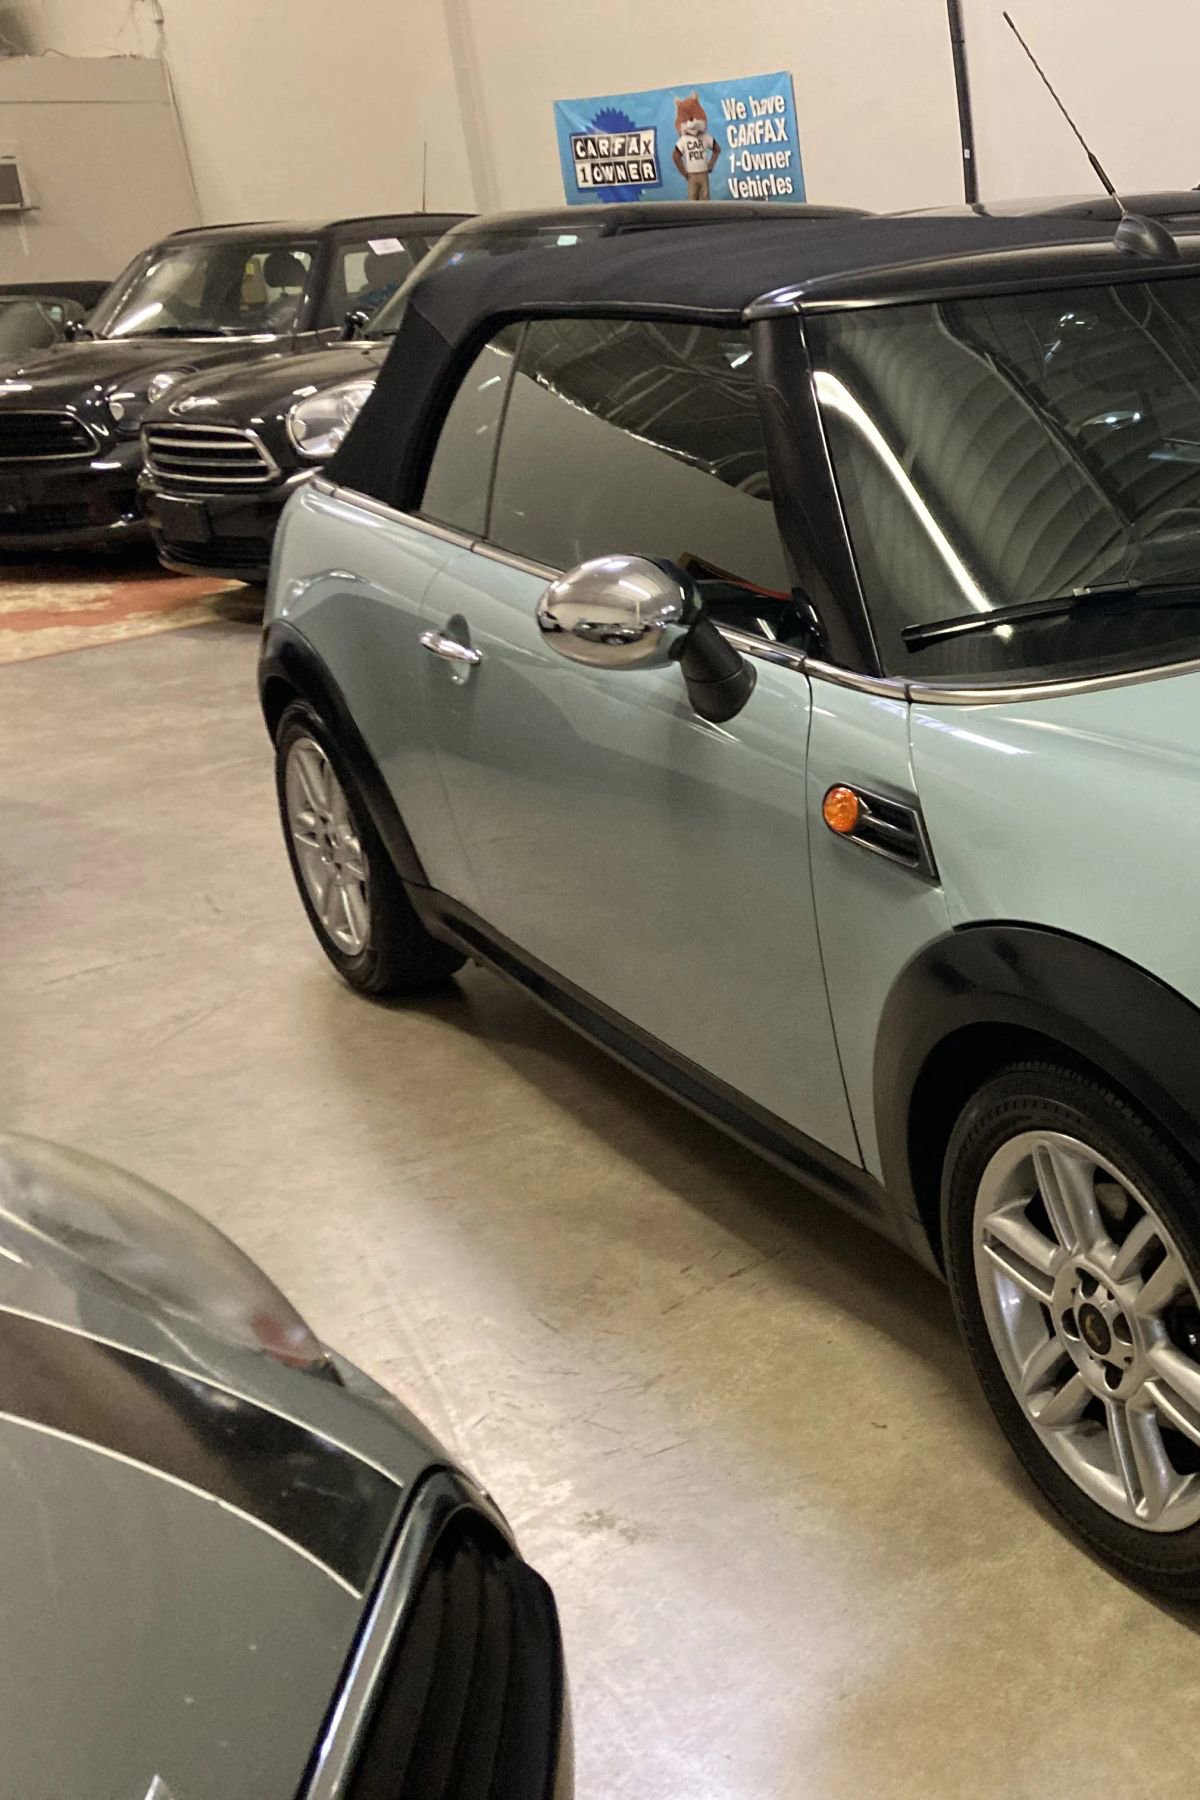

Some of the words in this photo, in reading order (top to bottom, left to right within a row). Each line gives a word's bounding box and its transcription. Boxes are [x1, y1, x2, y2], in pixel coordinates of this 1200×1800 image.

[721, 97, 747, 121] We
[748, 95, 785, 117] have
[726, 117, 789, 148] CARFAX
[575, 136, 652, 158] CARFAX
[686, 140, 704, 151] CAR
[688, 150, 705, 161] FOX
[581, 165, 589, 183] 1
[592, 162, 655, 182] OWNER
[728, 150, 791, 174] 1-Owner
[727, 173, 794, 199] Vehicles
